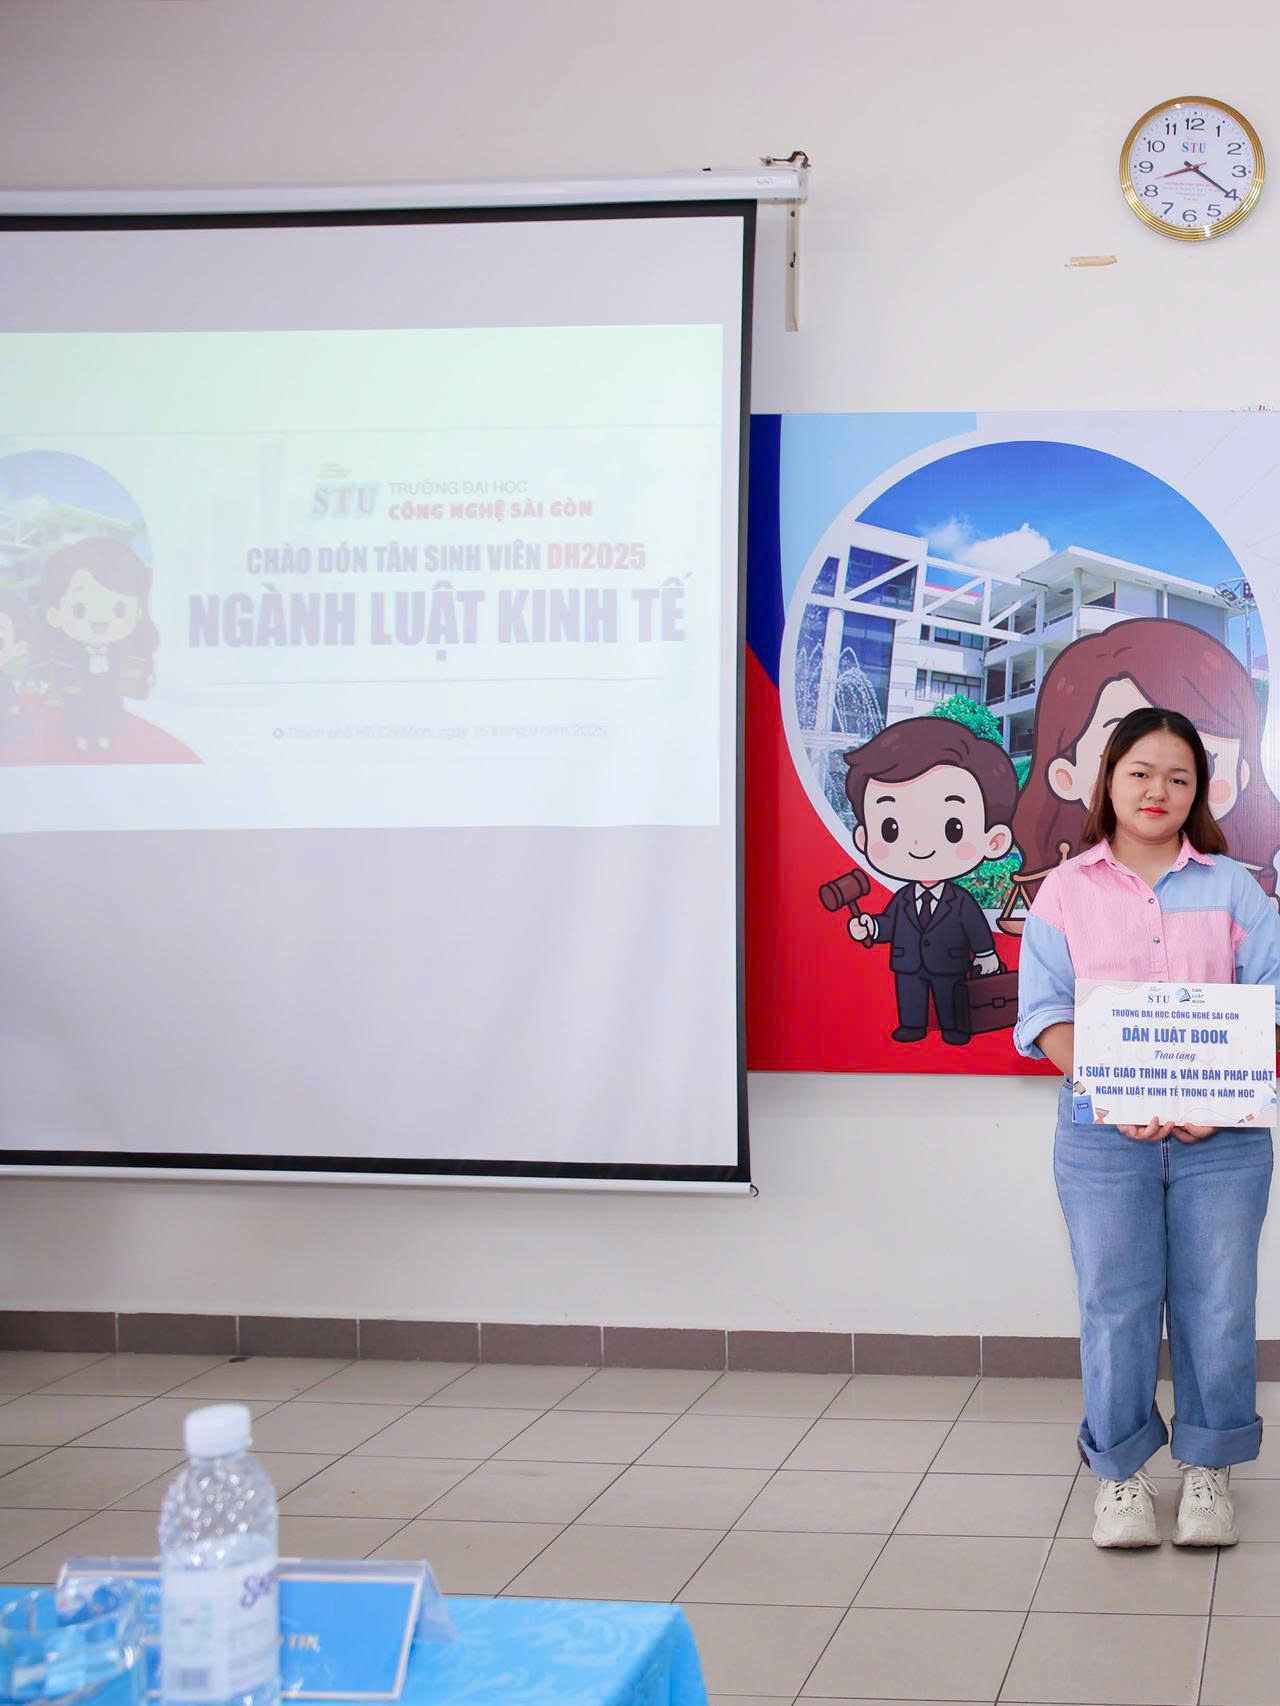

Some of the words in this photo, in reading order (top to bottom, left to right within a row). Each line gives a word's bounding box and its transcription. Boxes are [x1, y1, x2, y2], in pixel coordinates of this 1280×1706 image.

[1165, 123, 1177, 136] 11
[1185, 117, 1205, 131] 12
[1147, 140, 1165, 153] 10
[1181, 142, 1206, 154] STU
[1227, 142, 1242, 155] 2
[1139, 160, 1154, 174] 9
[1232, 165, 1247, 178] 3
[1144, 184, 1158, 197] 8
[1224, 188, 1239, 201] 4
[1161, 202, 1174, 216] 7
[1182, 209, 1197, 222] 6
[1207, 204, 1221, 217] 5
[388, 500, 442, 520] CÔNG
[510, 497, 544, 518] SÀI
[550, 498, 593, 517] GÒN
[247, 542, 312, 574] CHÀO
[372, 540, 418, 572] TÂN
[424, 544, 480, 571] SINH
[487, 539, 541, 570] VIÊN
[547, 542, 646, 570] DH2025
[188, 582, 356, 648] NGÀNH
[370, 579, 485, 661] LUẬT
[498, 588, 618, 644] KINH
[632, 571, 694, 642] TẾ
[1148, 994, 1169, 1003] STU
[1122, 1025, 1149, 1042] DÂN
[1154, 1026, 1186, 1046] LUẬT
[1191, 1029, 1228, 1044] BOOK
[1154, 1050, 1174, 1060] Trao
[1170, 1070, 1177, 1079] &
[1147, 1087, 1167, 1096] KINH
[1181, 1088, 1208, 1097] TRONG
